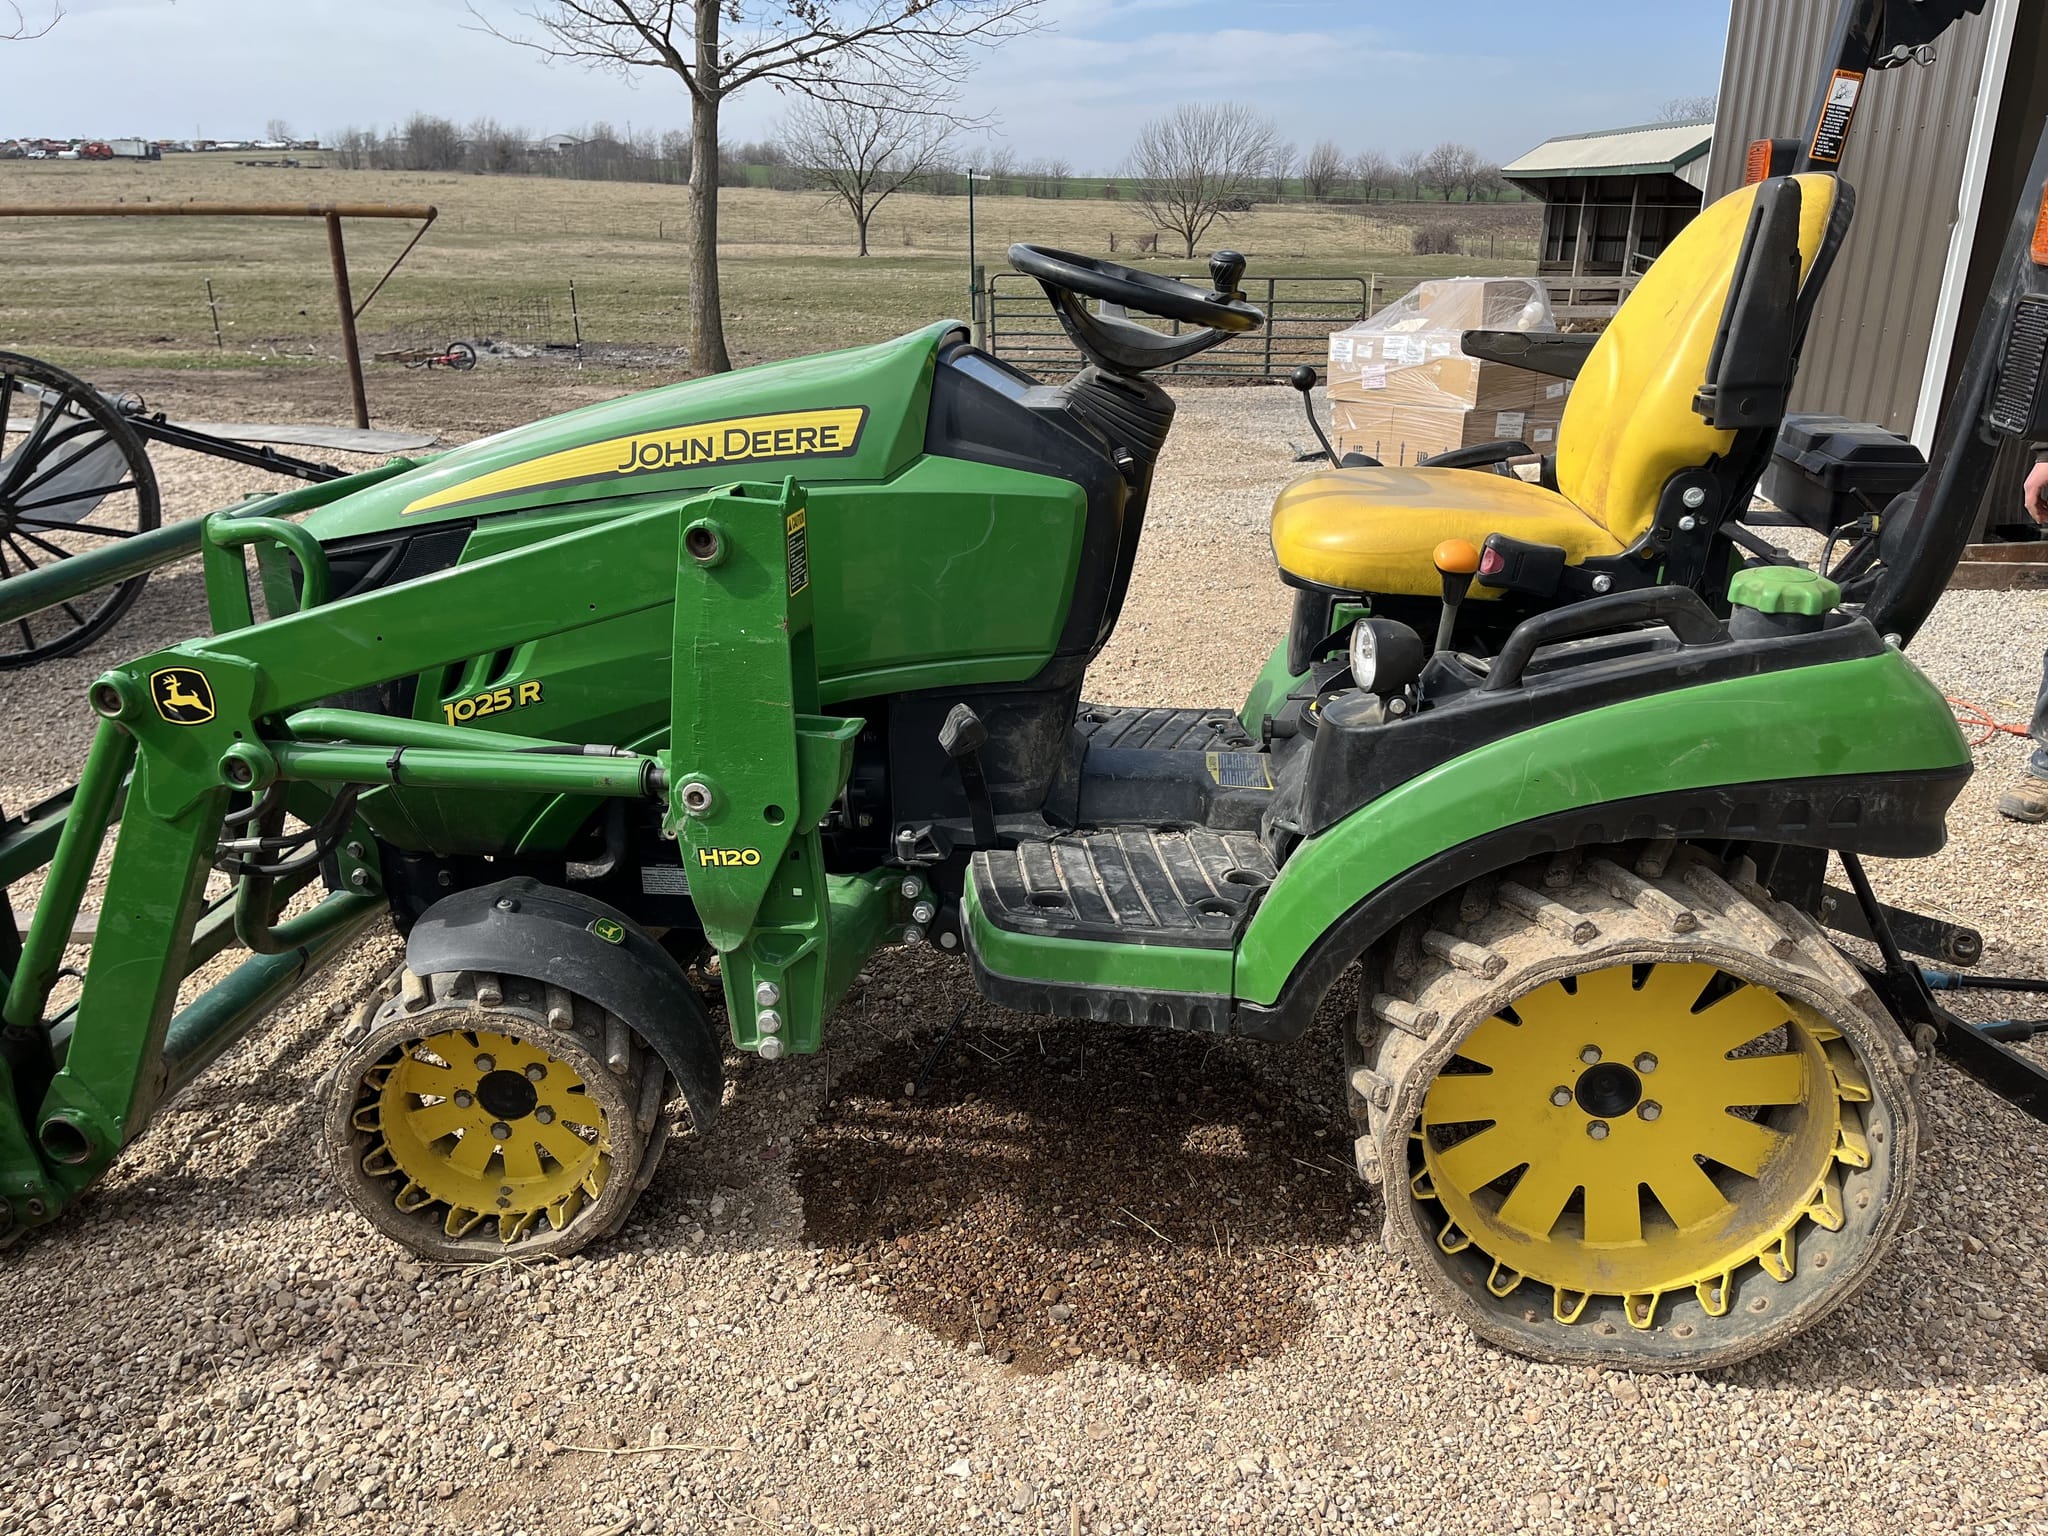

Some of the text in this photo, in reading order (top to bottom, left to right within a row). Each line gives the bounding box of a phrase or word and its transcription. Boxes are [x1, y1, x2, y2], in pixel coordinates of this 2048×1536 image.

[617, 424, 841, 470] JOHN DEERE
[443, 680, 542, 727] 1025 R
[699, 848, 761, 867] H120
